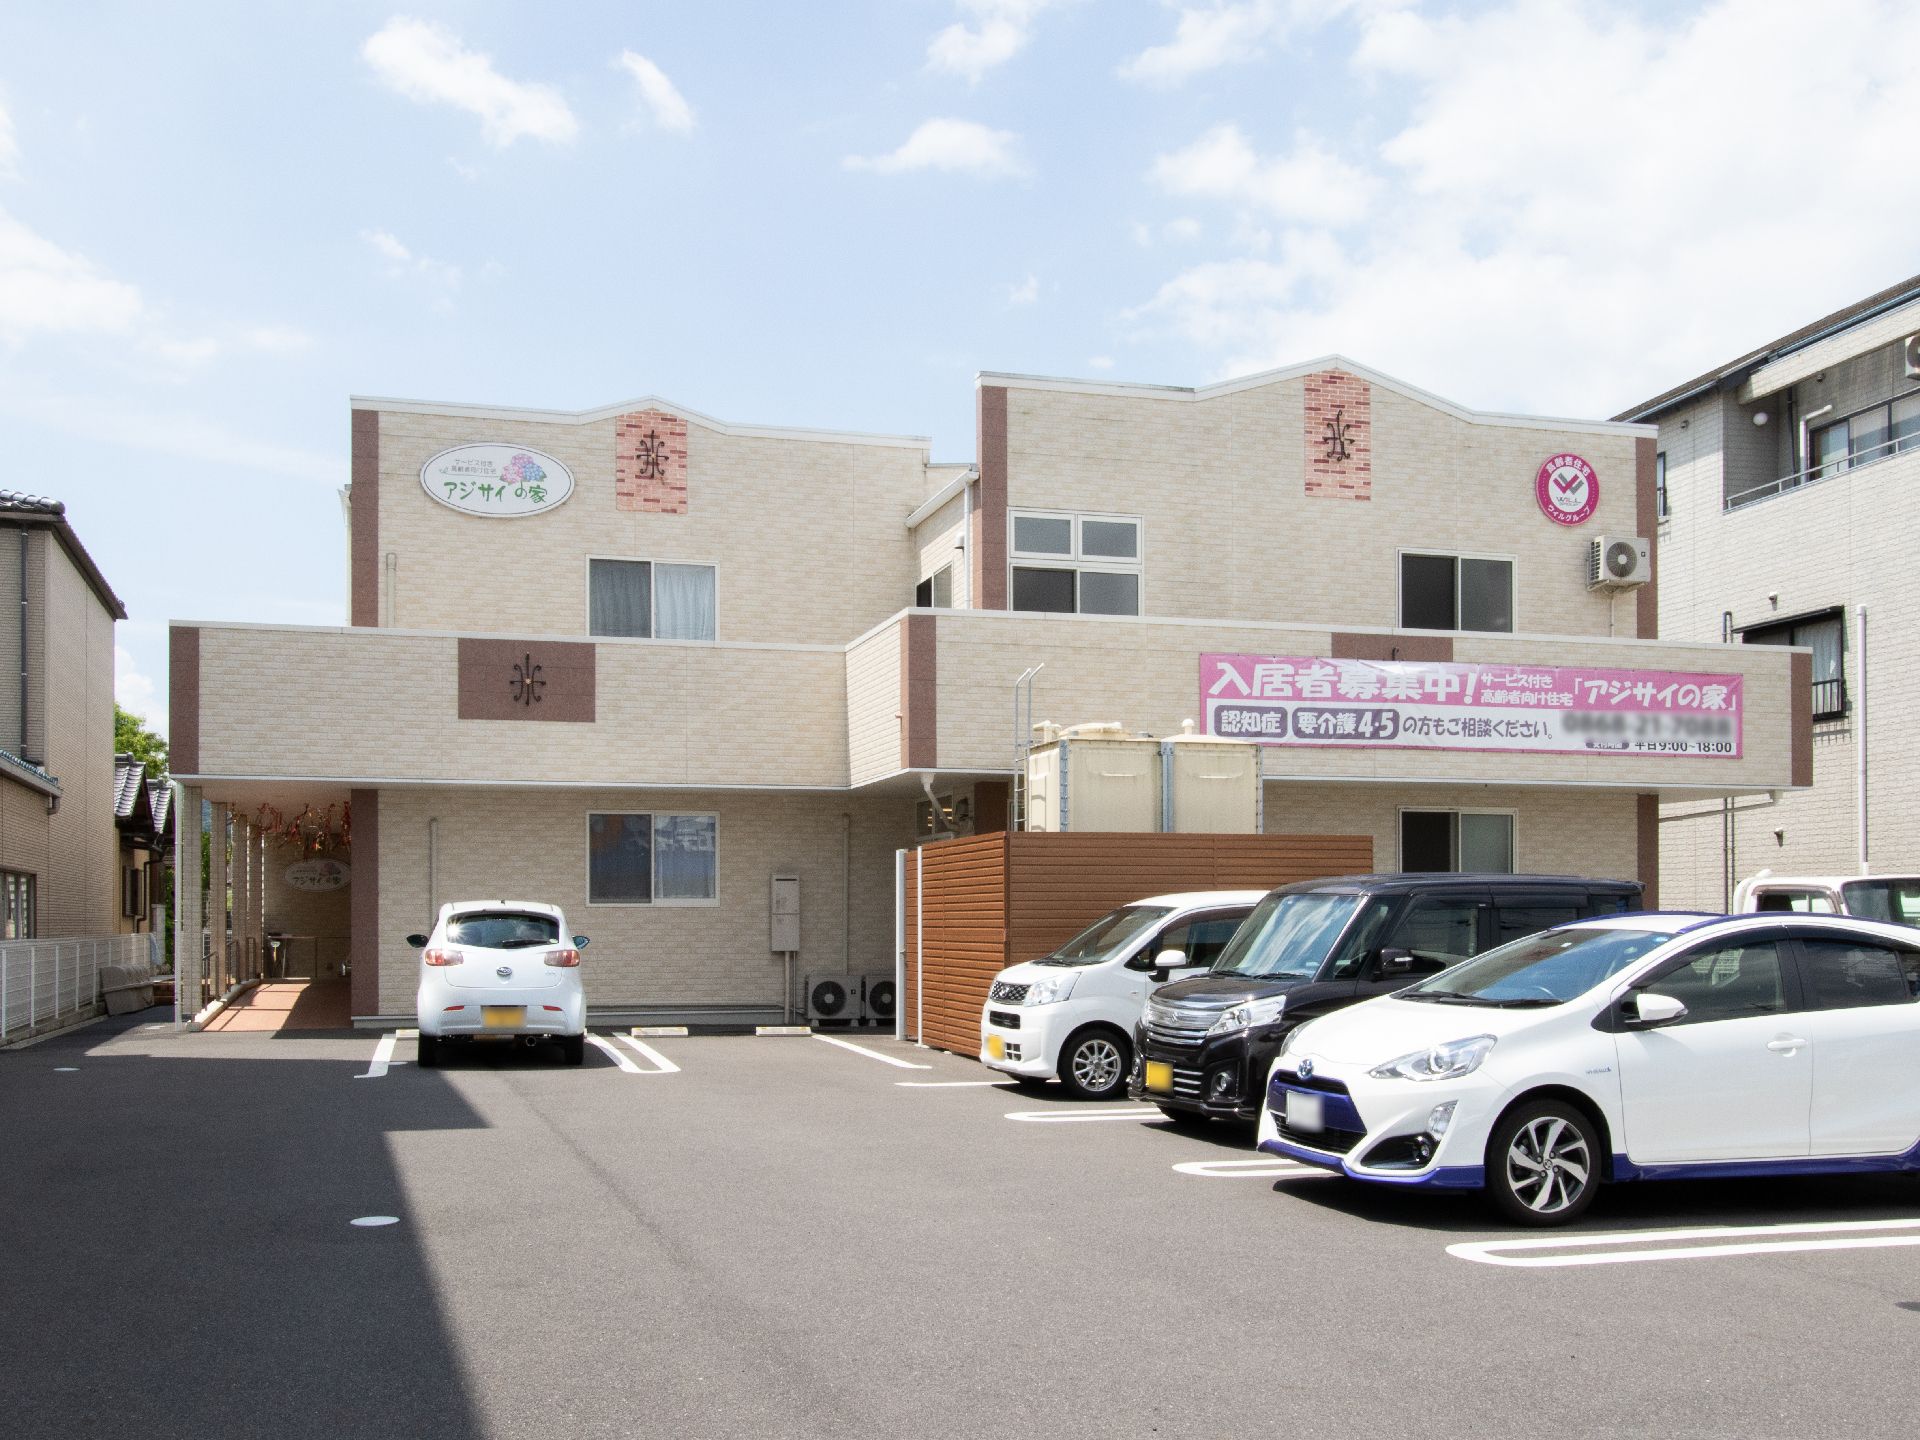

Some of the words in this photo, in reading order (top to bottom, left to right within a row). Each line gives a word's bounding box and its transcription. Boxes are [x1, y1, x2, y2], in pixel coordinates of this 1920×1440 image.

[443, 480, 548, 503] アジサイの家
[1208, 662, 1478, 705] 入居者募集中!
[1480, 672, 1553, 689] サービス付き
[1480, 689, 1574, 707] 高齢者向け住宅
[1574, 678, 1736, 711] 「アジサイの家」
[1221, 710, 1282, 733] 認知症
[1402, 715, 1553, 740] の方もご相談ください。
